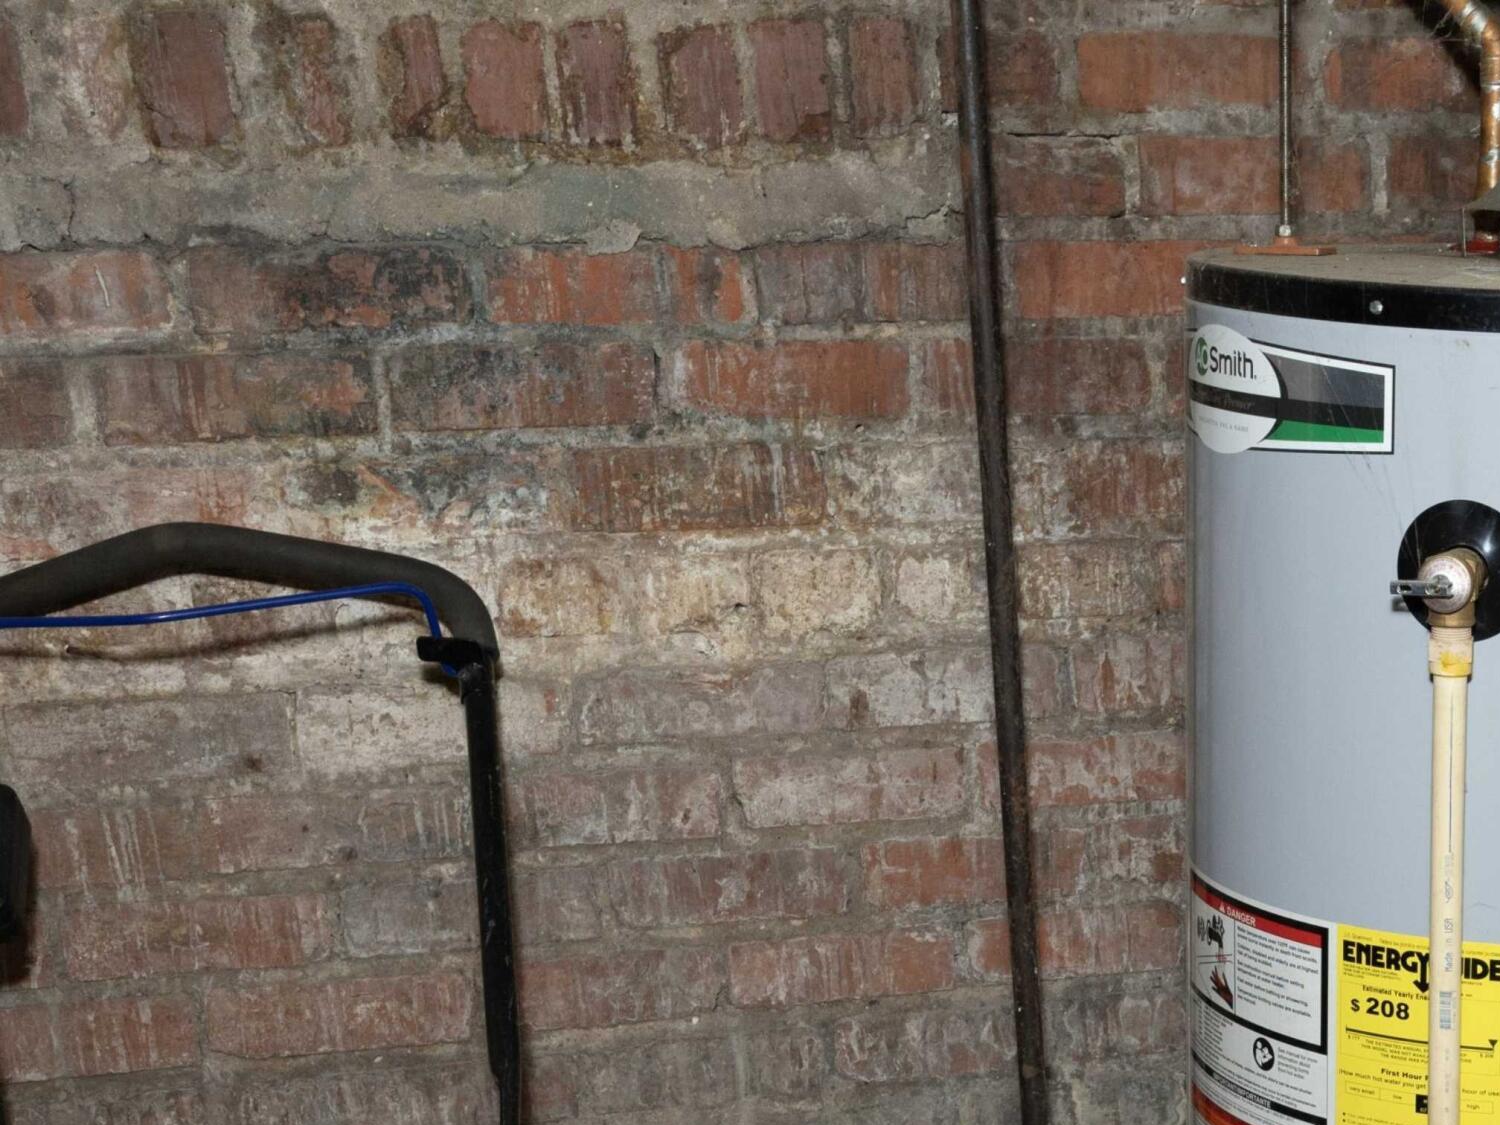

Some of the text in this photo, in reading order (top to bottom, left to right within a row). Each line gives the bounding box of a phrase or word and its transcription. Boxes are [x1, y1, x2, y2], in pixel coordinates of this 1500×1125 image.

[1227, 907, 1256, 927] DANGER
[1443, 918, 1454, 934] USA
[1443, 952, 1454, 972] Made
[1350, 997, 1410, 1020] $ 208
[1381, 1067, 1422, 1080] First Hour
